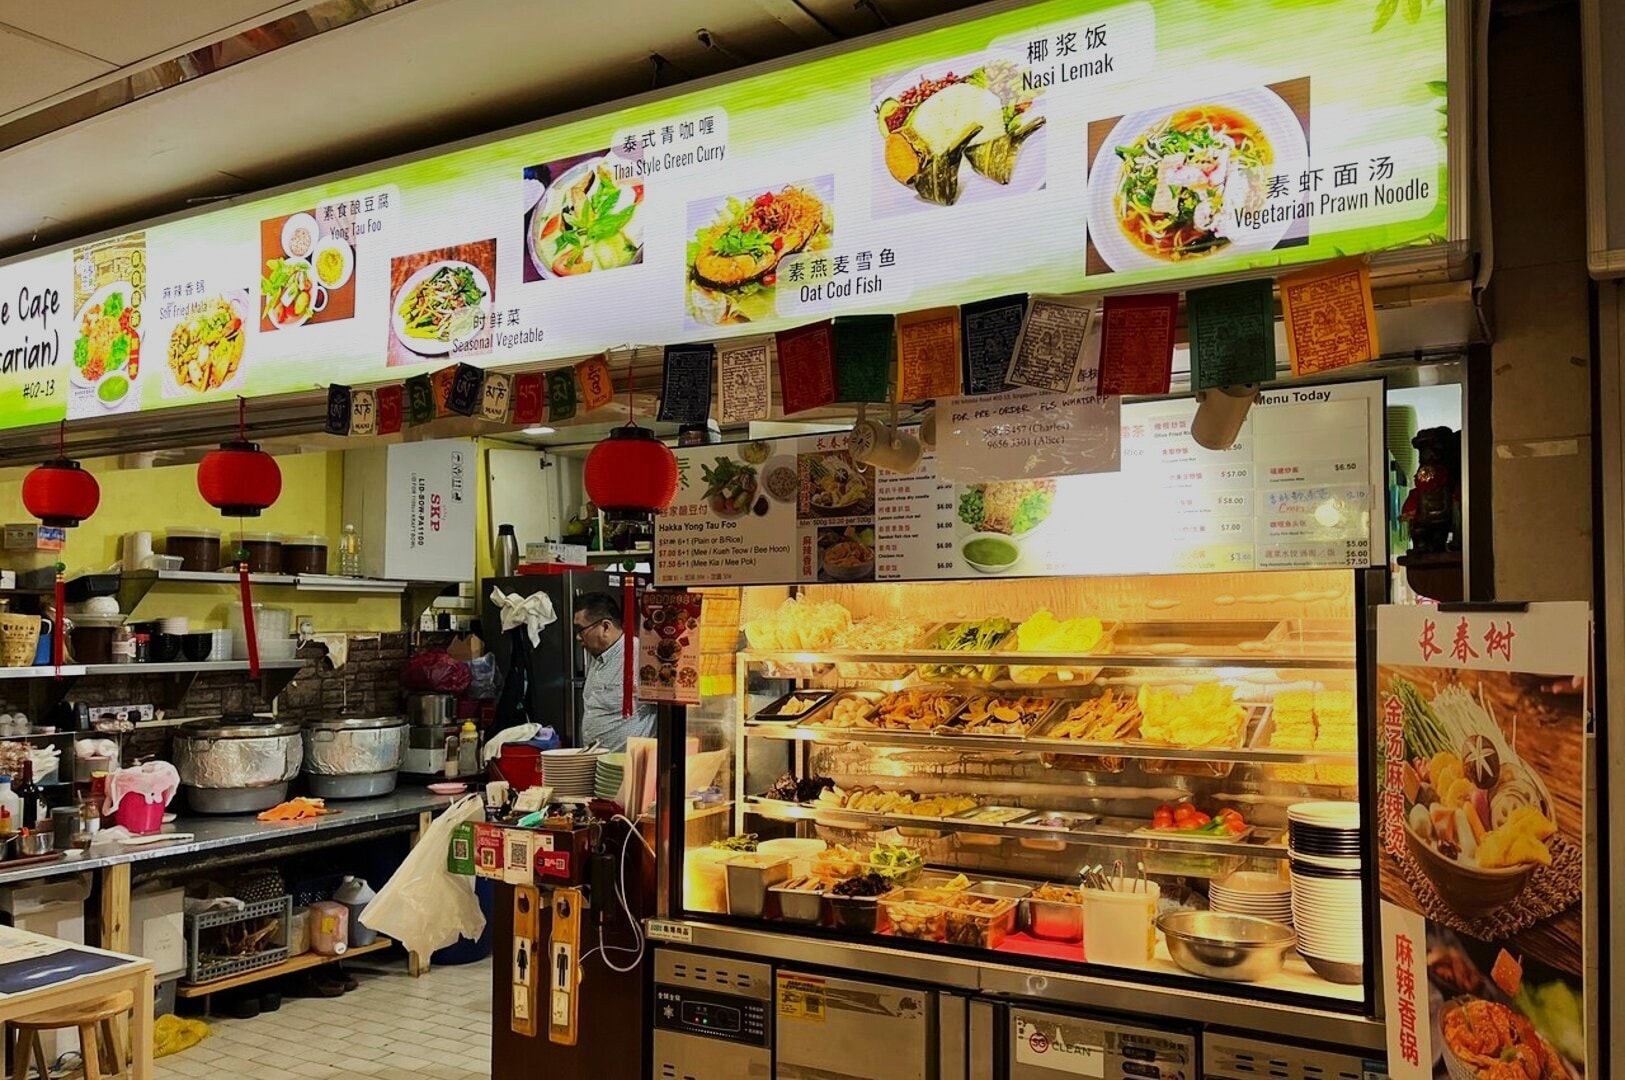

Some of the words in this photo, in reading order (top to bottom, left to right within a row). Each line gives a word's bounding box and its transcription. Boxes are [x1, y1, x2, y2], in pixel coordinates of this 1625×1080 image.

[1027, 24, 1107, 64] 椰浆饭
[1022, 68, 1055, 91] Nasi
[1061, 53, 1114, 83] Lemak
[623, 115, 715, 153] 泰式青咖喱
[614, 162, 633, 181] Thai
[636, 157, 661, 178] Style
[663, 152, 693, 172] Green
[696, 144, 725, 163] Curry
[1266, 155, 1394, 199] 素虾面汤
[324, 193, 388, 221] 素食酿豆腐
[1234, 198, 1314, 230] Vegetarian
[1320, 190, 1367, 215] Prawn
[1374, 178, 1429, 206] Noodle
[330, 226, 349, 240] Yong
[351, 222, 365, 236] Tau
[367, 219, 381, 233] Foo
[789, 248, 896, 282] 素燕麦雪鱼
[800, 283, 823, 302] Oat
[826, 279, 851, 299] Cod
[856, 275, 882, 295] Fish
[18, 286, 60, 330] Cafe
[473, 309, 520, 329] 时鲜菜
[452, 335, 493, 354] Seasonal
[496, 328, 544, 350] Vegetable
[23, 380, 55, 399] #02-13
[1292, 390, 1330, 402] Today
[431, 494, 441, 532] SKP
[659, 523, 682, 532] Hakka
[684, 522, 703, 533] Yong
[705, 521, 720, 529] Tau
[721, 520, 737, 528] Foo
[691, 548, 708, 557] (Mee
[754, 546, 767, 554] Bee
[769, 545, 791, 554] Hoon)
[691, 559, 708, 569] (Mee
[725, 557, 739, 566] Mee
[1345, 558, 1368, 566] $7.50
[1346, 550, 1368, 558] $6.00
[1418, 616, 1515, 664] 长春树
[1385, 694, 1405, 857] 金汤麻辣烫
[1396, 934, 1418, 1067] 麻辣香锅
[1051, 1041, 1091, 1058] CLEAN
